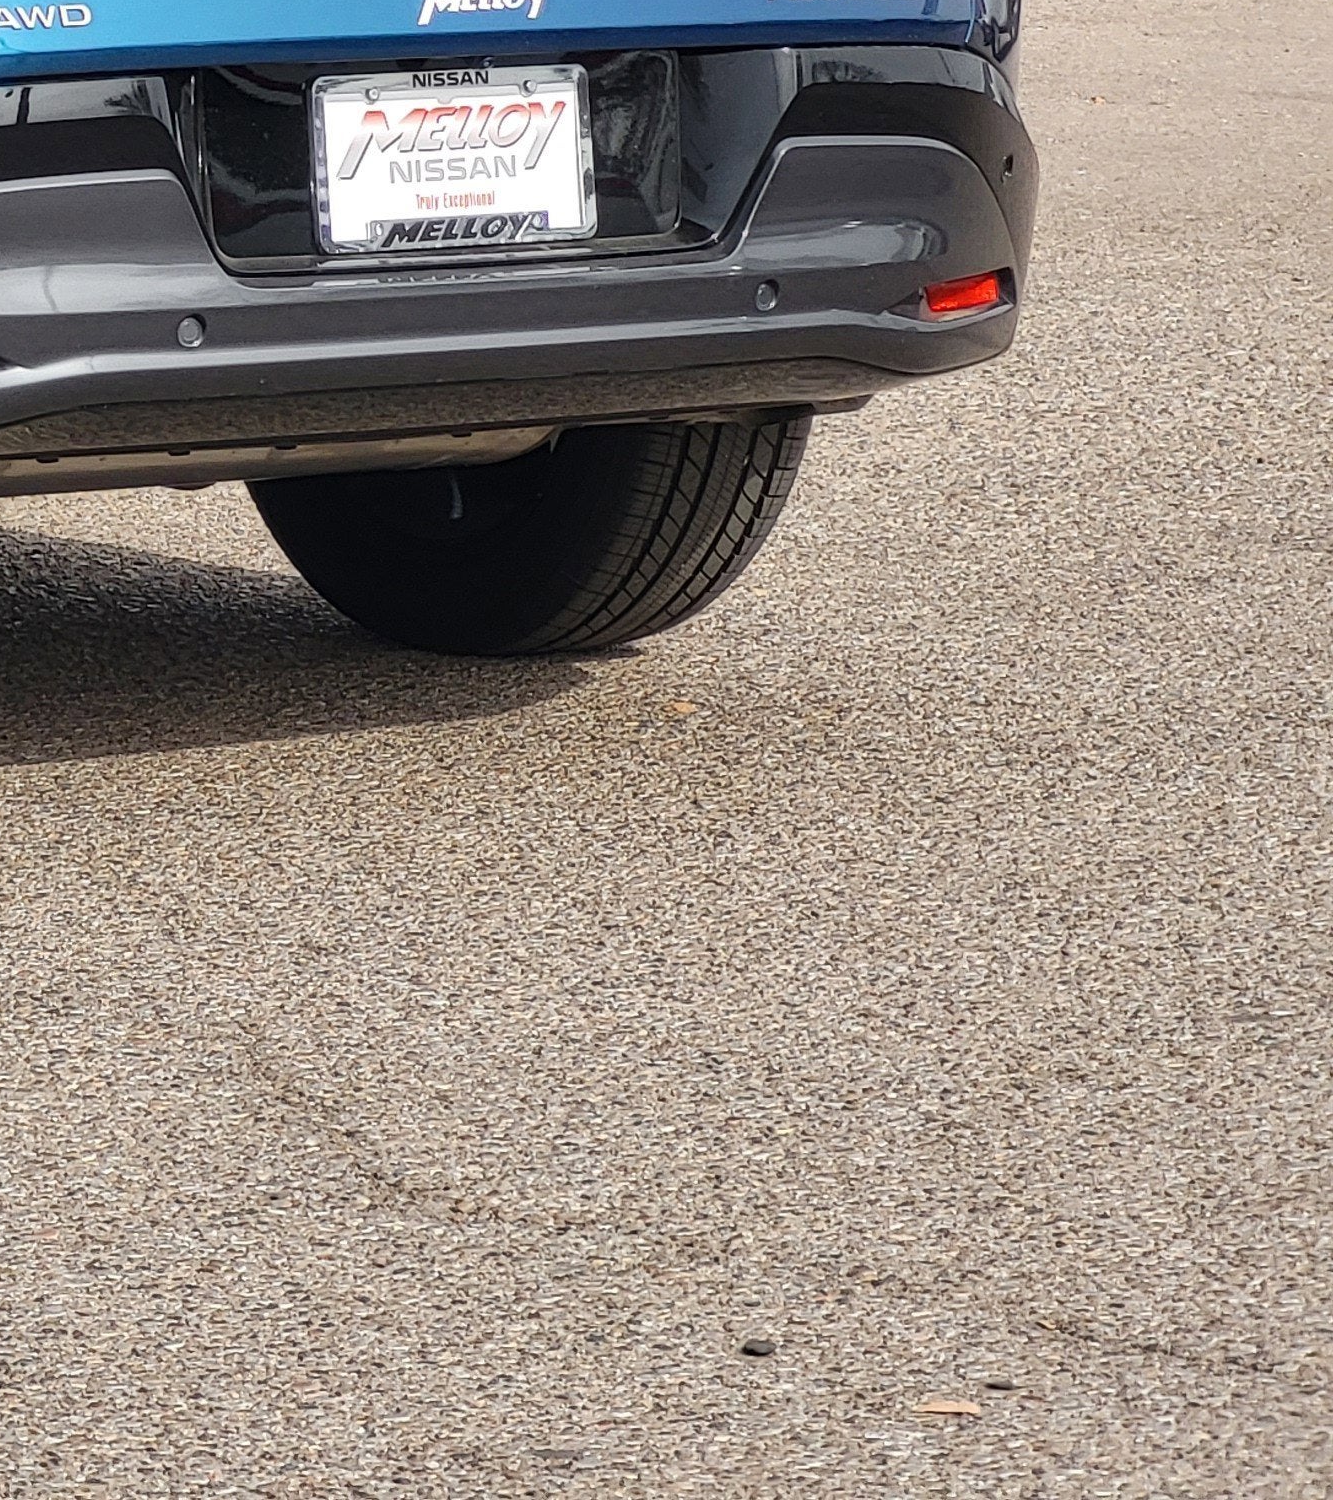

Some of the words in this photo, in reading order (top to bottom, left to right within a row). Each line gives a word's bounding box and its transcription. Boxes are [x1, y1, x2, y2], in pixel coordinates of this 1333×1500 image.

[411, 70, 490, 88] NISSAN
[335, 101, 566, 181] MELLOY
[388, 154, 517, 184] NISSAN
[415, 193, 440, 211] Truly
[443, 190, 496, 210] Exceptional
[381, 210, 532, 248] MELLOY
